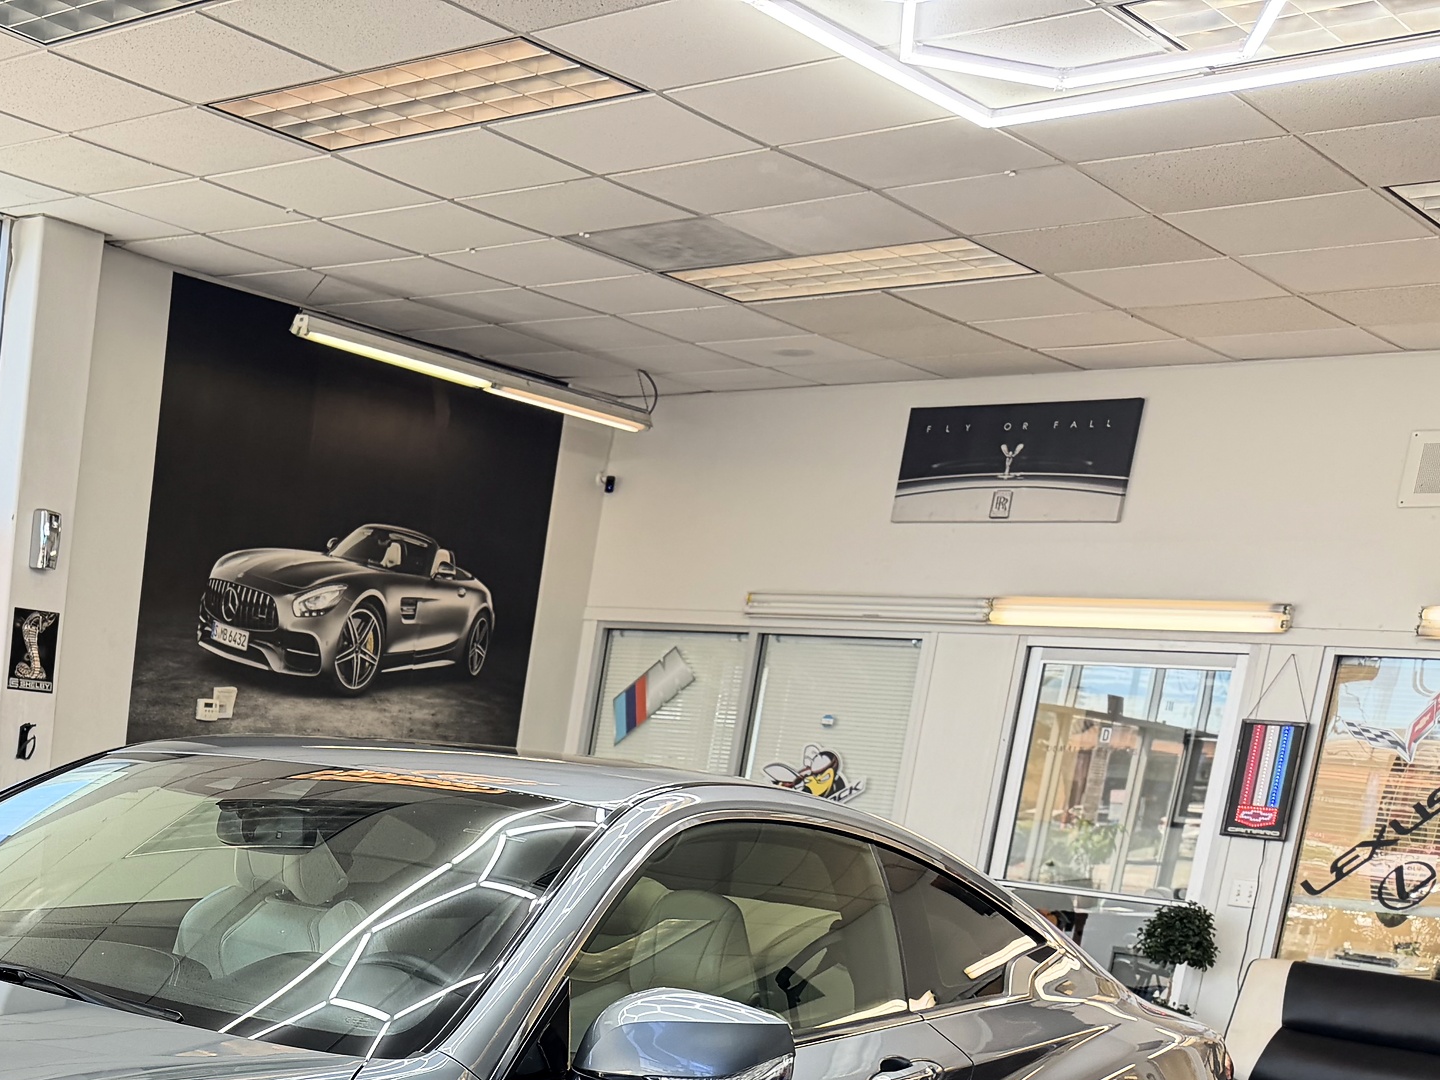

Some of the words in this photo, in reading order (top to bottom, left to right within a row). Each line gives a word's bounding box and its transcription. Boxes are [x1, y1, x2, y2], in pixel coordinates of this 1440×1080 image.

[926, 424, 971, 433] FLY
[1003, 422, 1029, 431] OR
[1053, 419, 1112, 429] FALL
